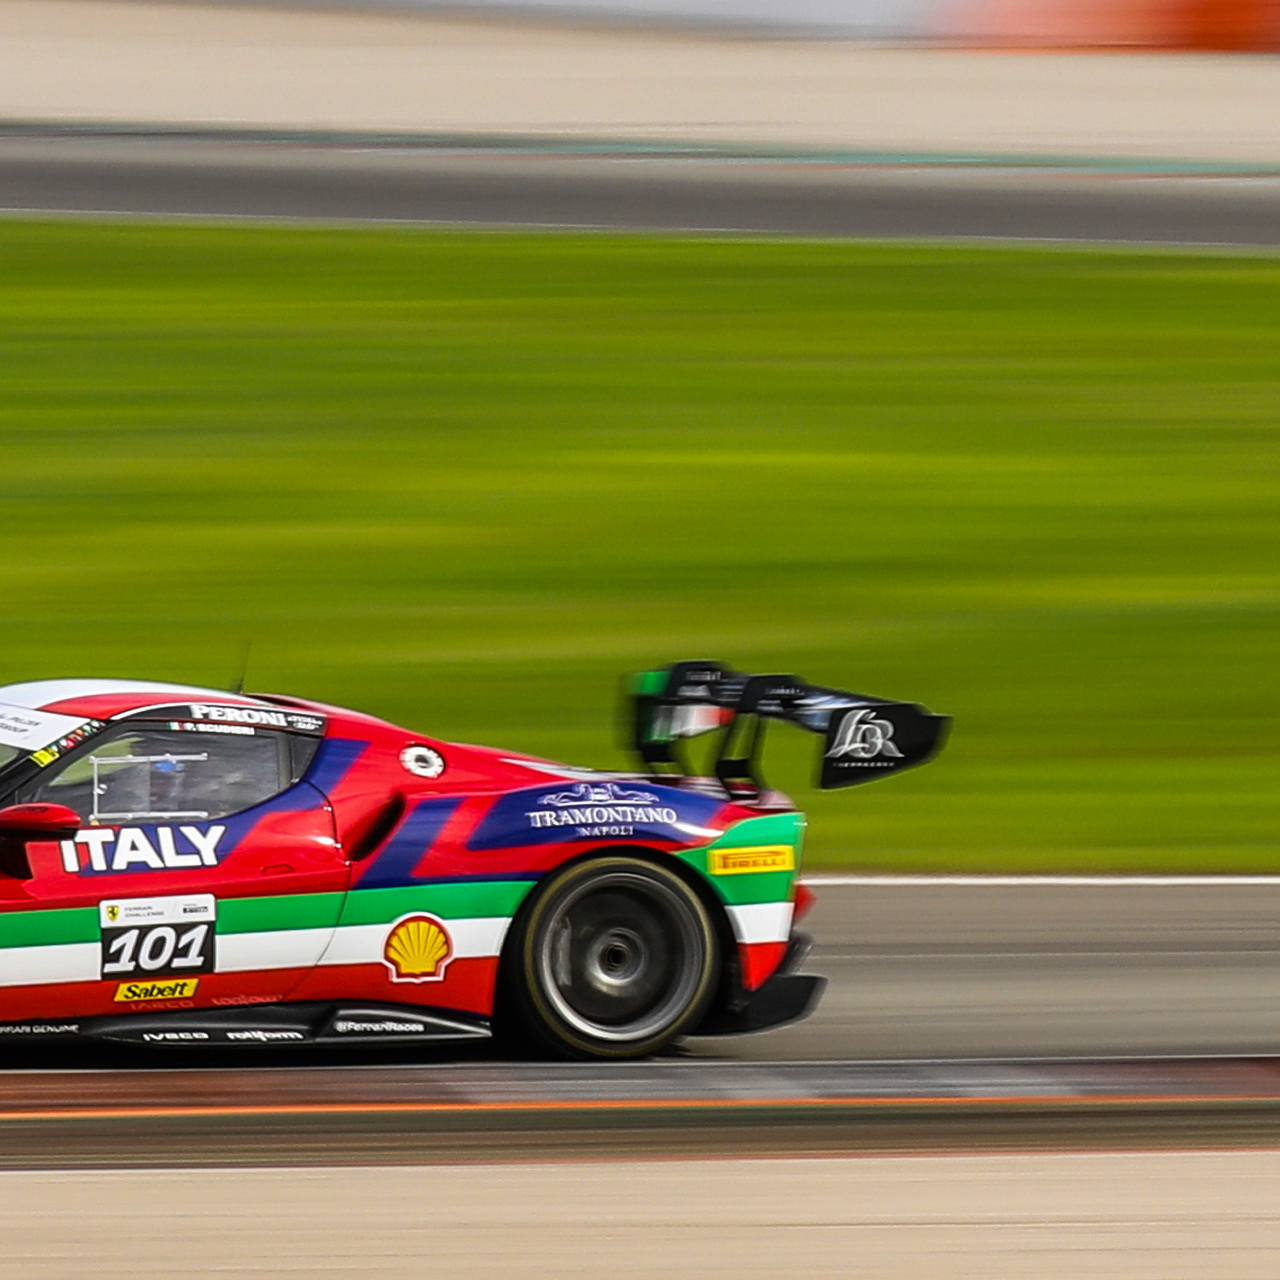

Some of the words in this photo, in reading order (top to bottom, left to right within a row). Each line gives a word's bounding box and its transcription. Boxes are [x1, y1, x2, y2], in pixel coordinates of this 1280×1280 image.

[191, 704, 288, 727] PERONI
[525, 806, 678, 828] TRAMONTANO
[576, 825, 634, 837] NAPOLI
[60, 825, 227, 873] ITALY
[717, 850, 787, 870] PIRELLI
[103, 924, 209, 974] 101
[123, 982, 189, 1000] Sabelt
[143, 1031, 209, 1042] IVECO
